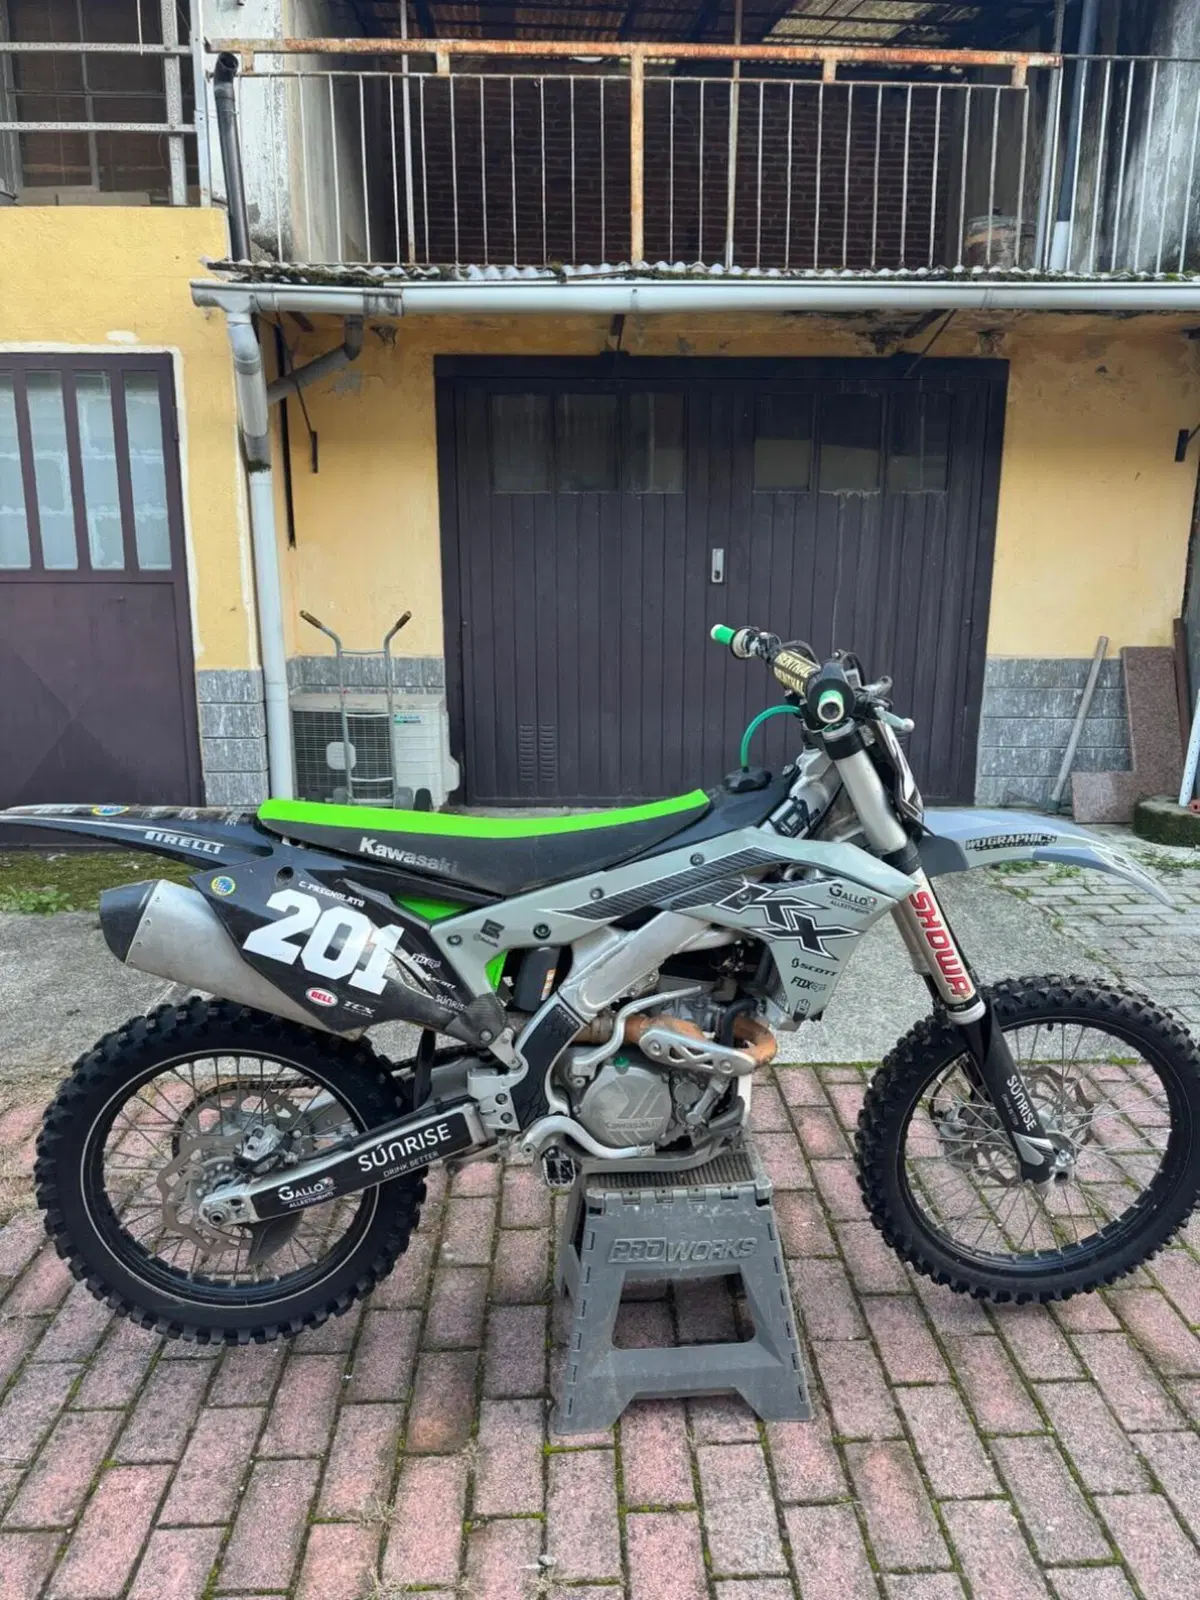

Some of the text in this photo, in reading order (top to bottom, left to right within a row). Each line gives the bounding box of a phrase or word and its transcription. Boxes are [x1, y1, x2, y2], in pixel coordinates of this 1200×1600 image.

[144, 831, 224, 855] PIRELLI
[359, 836, 459, 874] Kawasaki
[714, 882, 866, 961] KX
[242, 888, 405, 996] 201
[908, 890, 971, 996] SHOWA
[310, 990, 333, 1004] BELL
[383, 1151, 440, 1178] DRINK BETTER
[278, 1183, 324, 1201] GALLO
